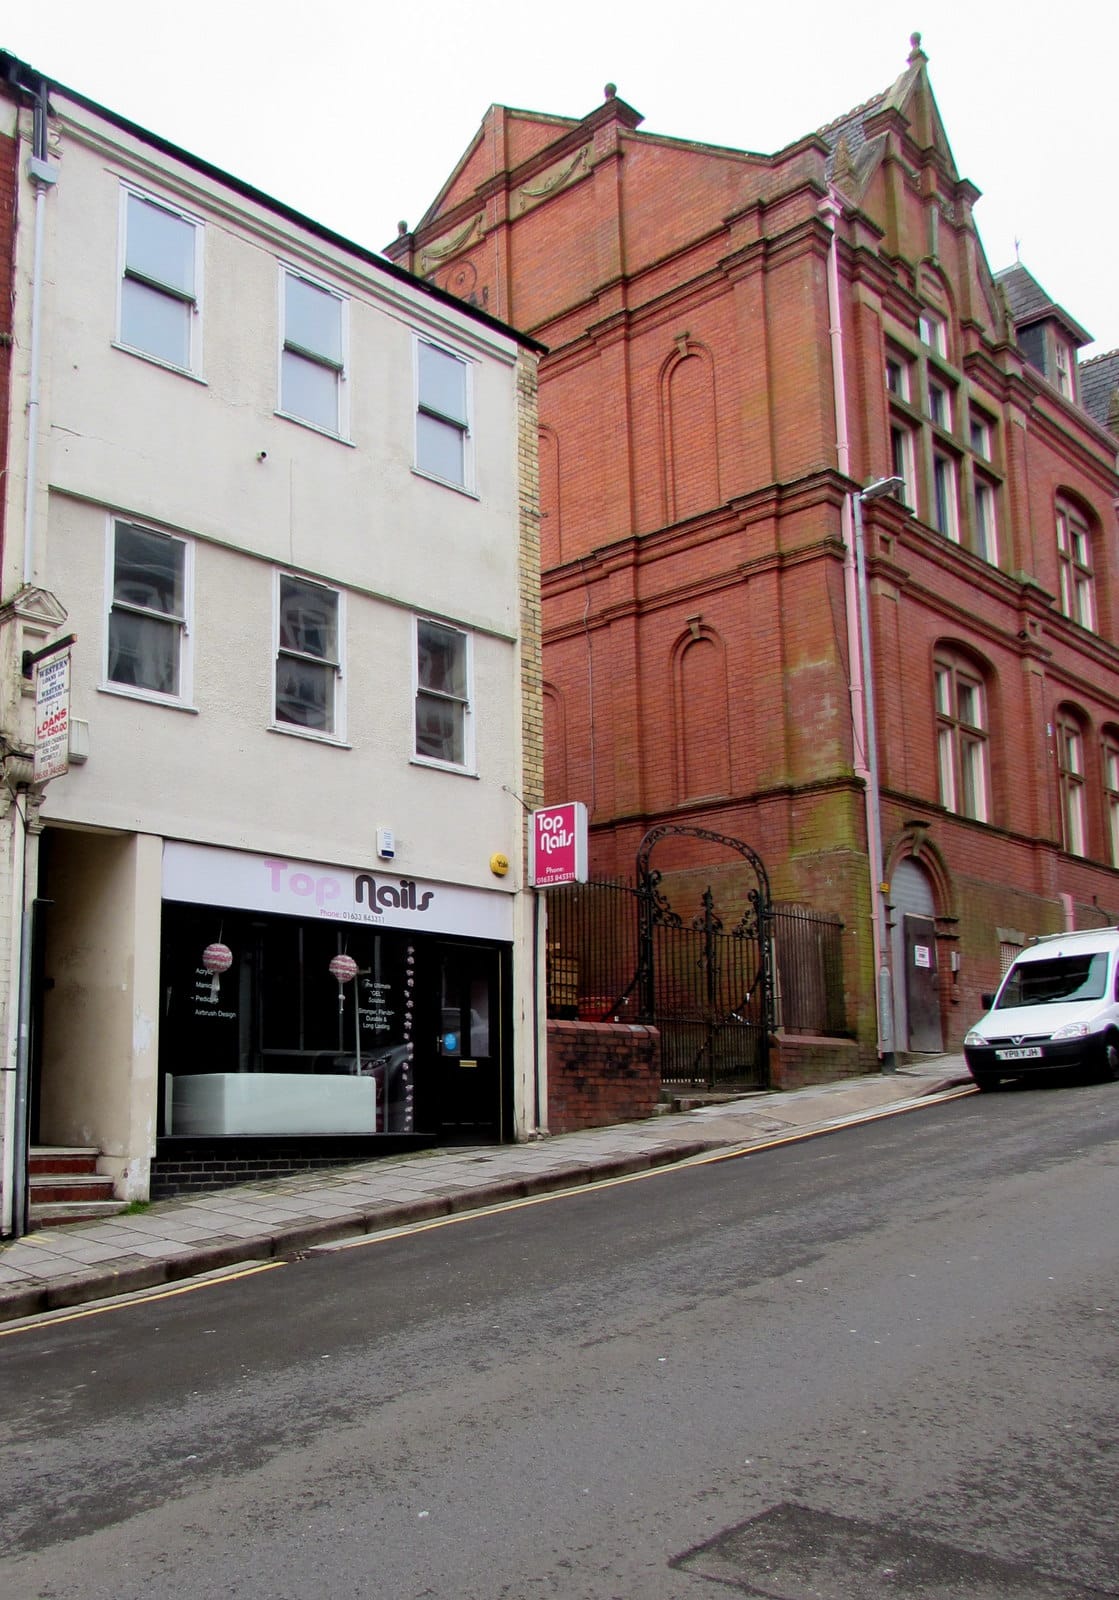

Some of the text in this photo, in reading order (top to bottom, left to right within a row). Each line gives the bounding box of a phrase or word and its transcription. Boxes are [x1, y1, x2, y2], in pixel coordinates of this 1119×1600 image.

[39, 659, 67, 678] WESTERN
[37, 707, 67, 735] LOANS
[537, 813, 563, 834] Top
[264, 859, 341, 907] Top
[342, 911, 362, 921] 01633
